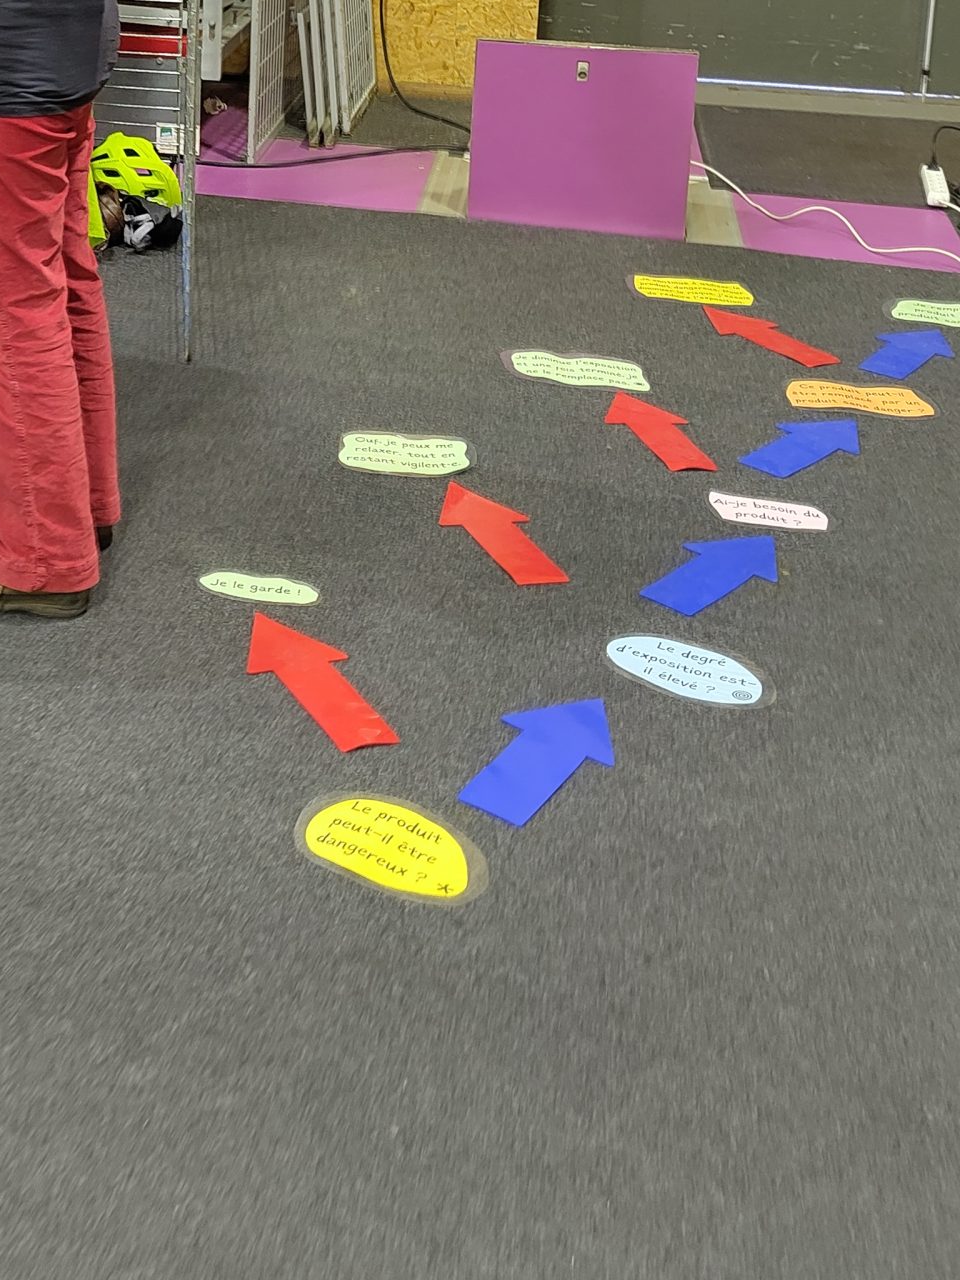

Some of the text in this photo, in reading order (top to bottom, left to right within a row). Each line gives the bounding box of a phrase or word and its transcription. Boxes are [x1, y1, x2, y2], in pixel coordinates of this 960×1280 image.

[898, 312, 939, 320] produit
[915, 308, 955, 317] produit
[531, 354, 572, 365] diminue
[575, 360, 637, 372] l'exposition
[555, 372, 604, 382] remplace
[819, 384, 861, 395] produit
[821, 391, 872, 403] remplacé
[795, 397, 837, 405] produit
[843, 400, 869, 409] sans
[874, 405, 912, 415] danger
[384, 438, 397, 446] je
[401, 442, 430, 450] peux
[346, 455, 396, 465] restant
[713, 498, 822, 519] Ai-je besoin du
[735, 511, 788, 524] produit
[210, 578, 227, 587] Je
[232, 580, 245, 589] le
[249, 585, 291, 595] garde
[656, 641, 727, 667] Le degré
[616, 644, 757, 688] d'exposition est-
[643, 666, 654, 676] il
[658, 671, 698, 691] élevé
[350, 801, 443, 845] Le produit
[328, 817, 438, 865] peut-il être
[316, 832, 409, 877] dangereux
